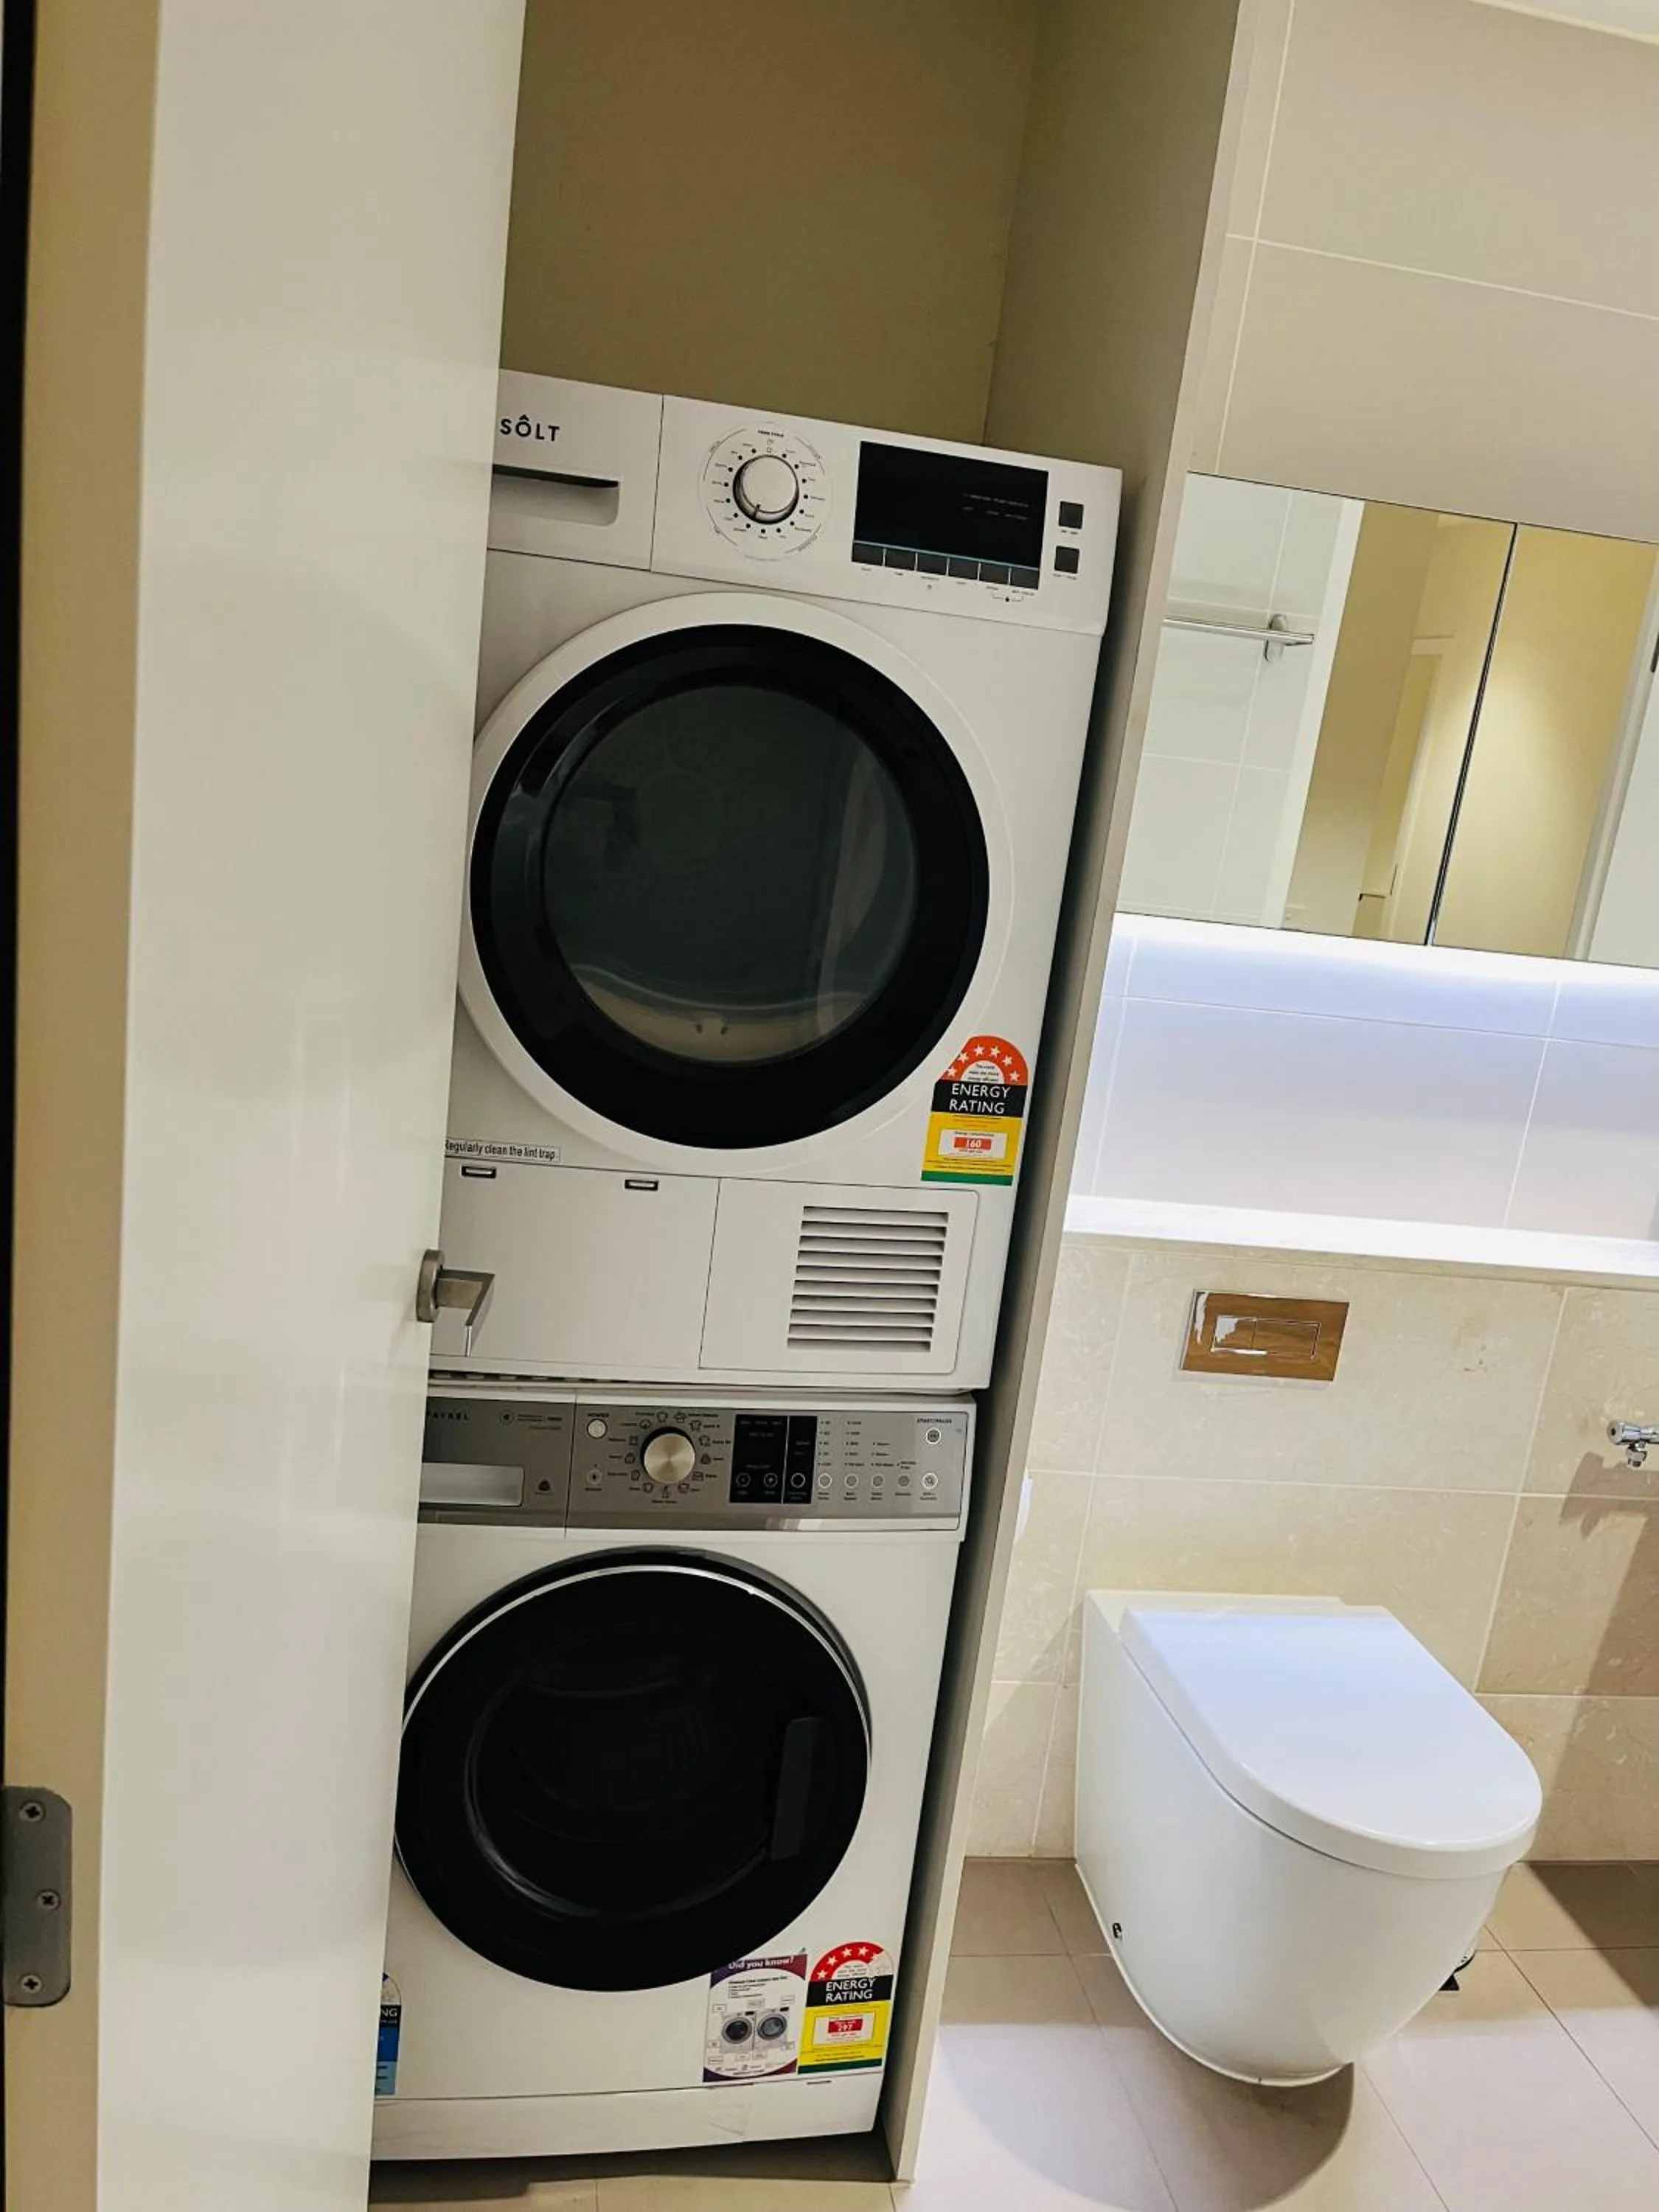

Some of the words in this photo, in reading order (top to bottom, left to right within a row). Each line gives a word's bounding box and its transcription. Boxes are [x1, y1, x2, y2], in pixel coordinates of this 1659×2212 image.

[499, 414, 560, 442] SÔLT
[951, 1083, 1011, 1099] ENERGY
[949, 1099, 1006, 1114] RATING
[484, 1144, 508, 1155] clean
[509, 1145, 523, 1157] the
[524, 1147, 538, 1158] lint
[967, 1139, 982, 1149] 160
[826, 1978, 877, 1992] ENERGY
[825, 1989, 874, 2003] RATING
